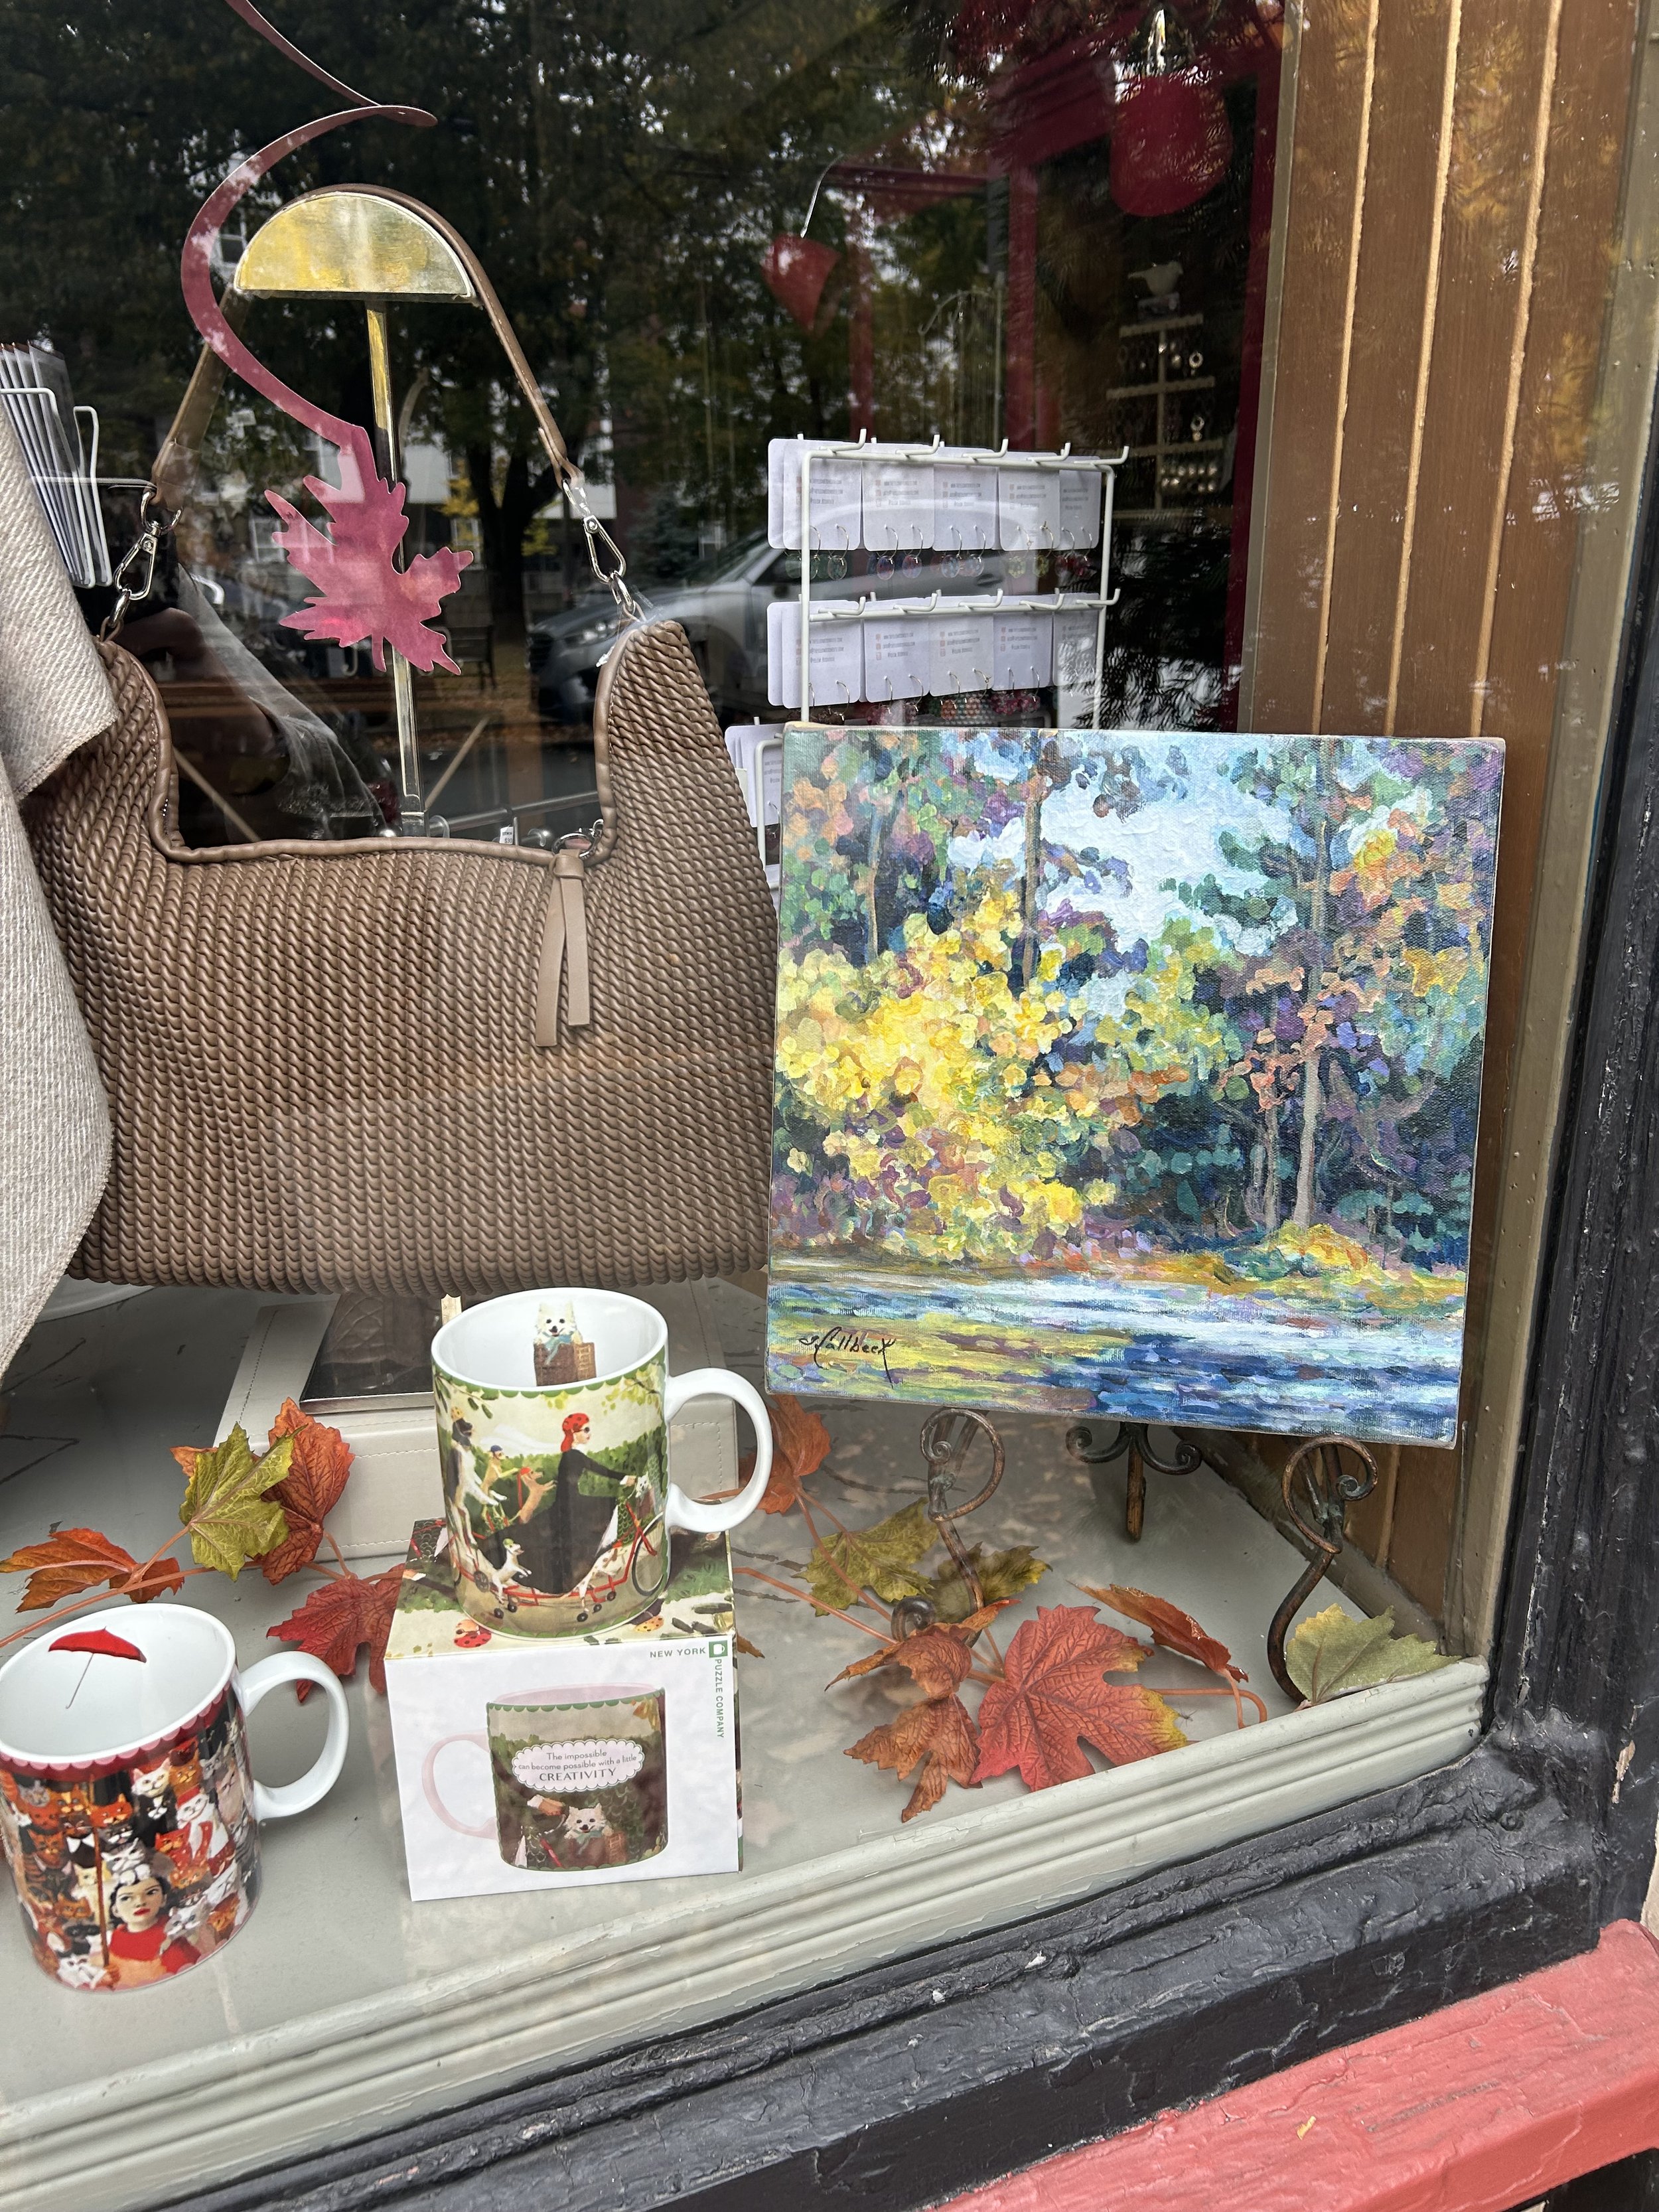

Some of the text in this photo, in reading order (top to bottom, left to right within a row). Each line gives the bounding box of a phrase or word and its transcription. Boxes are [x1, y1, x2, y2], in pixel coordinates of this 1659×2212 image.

[677, 1647, 706, 1656] YORK
[715, 1659, 725, 1738] PUZZLE COMPANY
[565, 1749, 607, 1761] impossible
[531, 1762, 561, 1771] become
[563, 1760, 597, 1771] possible
[599, 1758, 614, 1767] with
[622, 1754, 637, 1763] little
[539, 1767, 616, 1781] CREATIVITY
